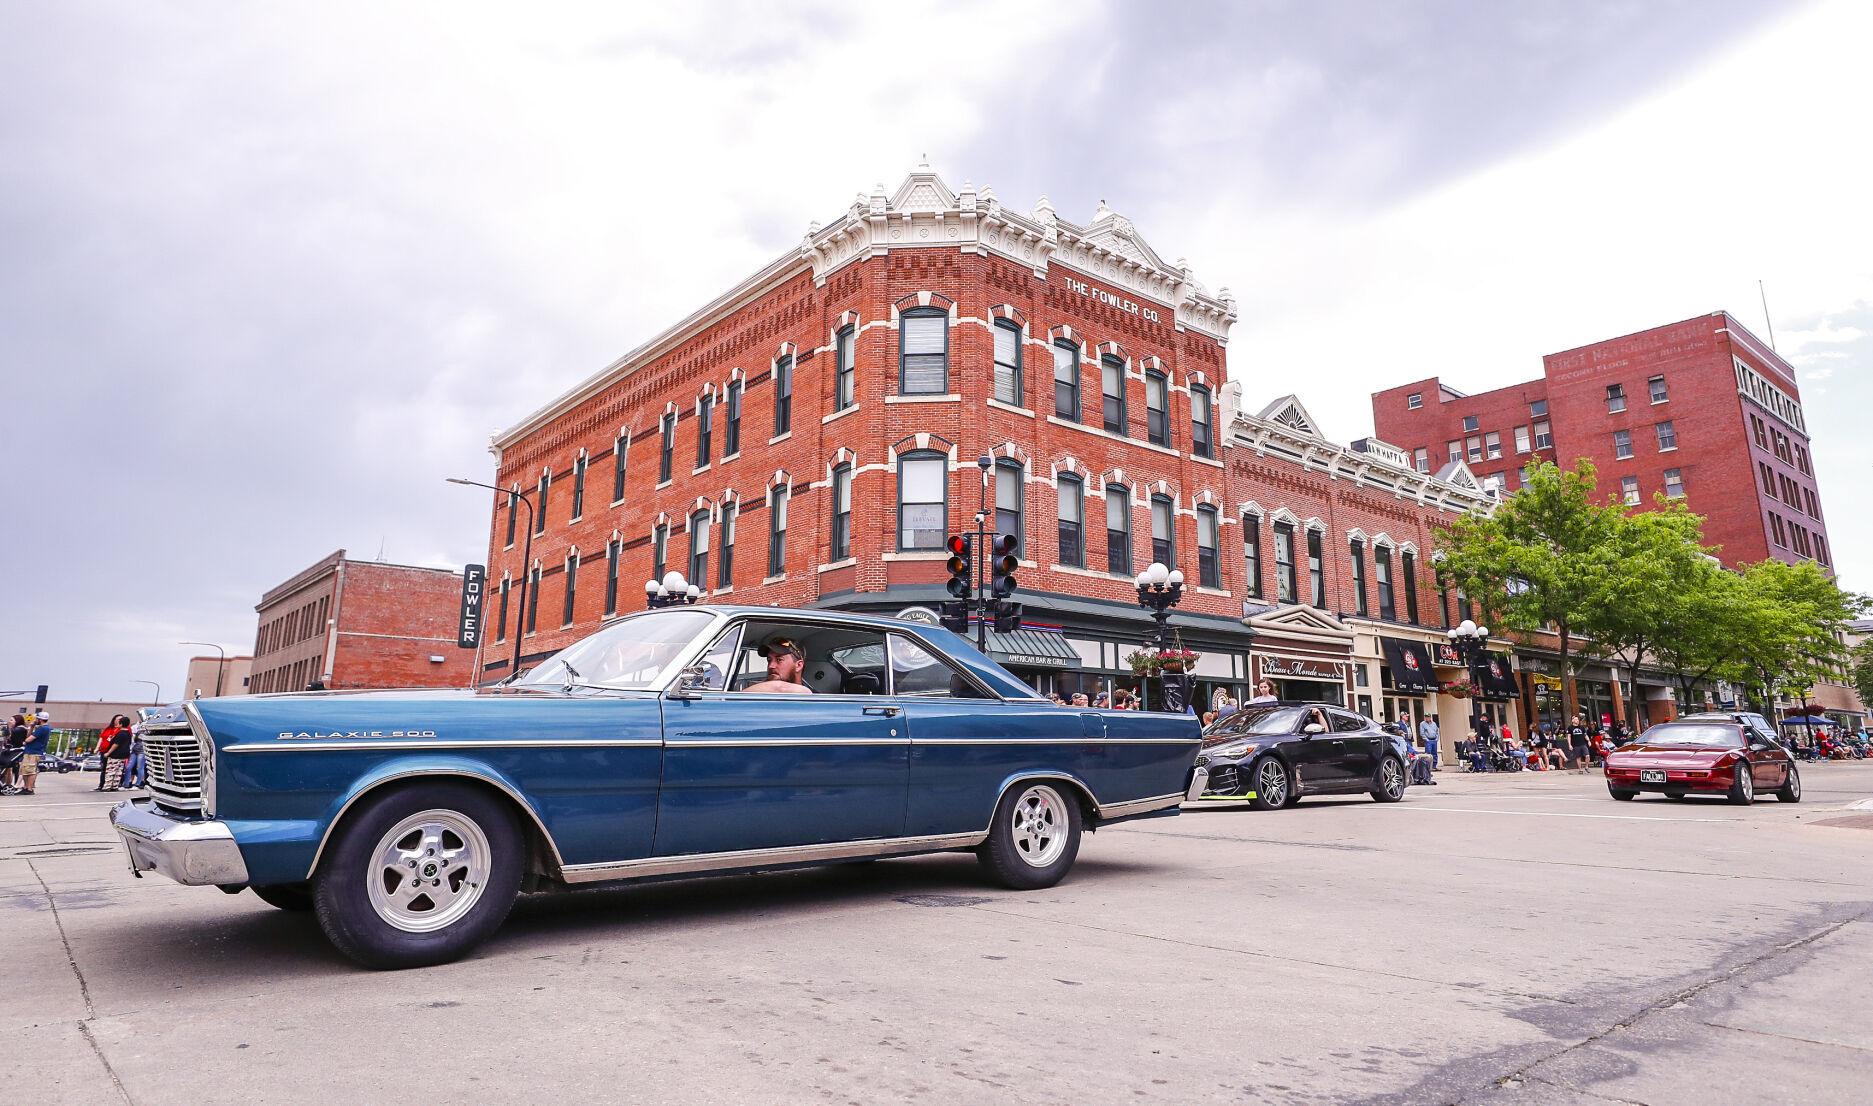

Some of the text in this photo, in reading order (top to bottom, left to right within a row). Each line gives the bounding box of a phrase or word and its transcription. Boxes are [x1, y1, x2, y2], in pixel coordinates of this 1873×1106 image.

[1064, 277, 1162, 324] THE FOWLER CO.
[463, 570, 480, 642] FOWLER
[1008, 654, 1035, 663] AMERICAN
[1035, 656, 1047, 664] BAR
[1052, 658, 1068, 666] GRILL
[1263, 660, 1287, 675] Beau
[1287, 661, 1318, 677] Monde
[278, 730, 436, 739] GALAXIE 500
